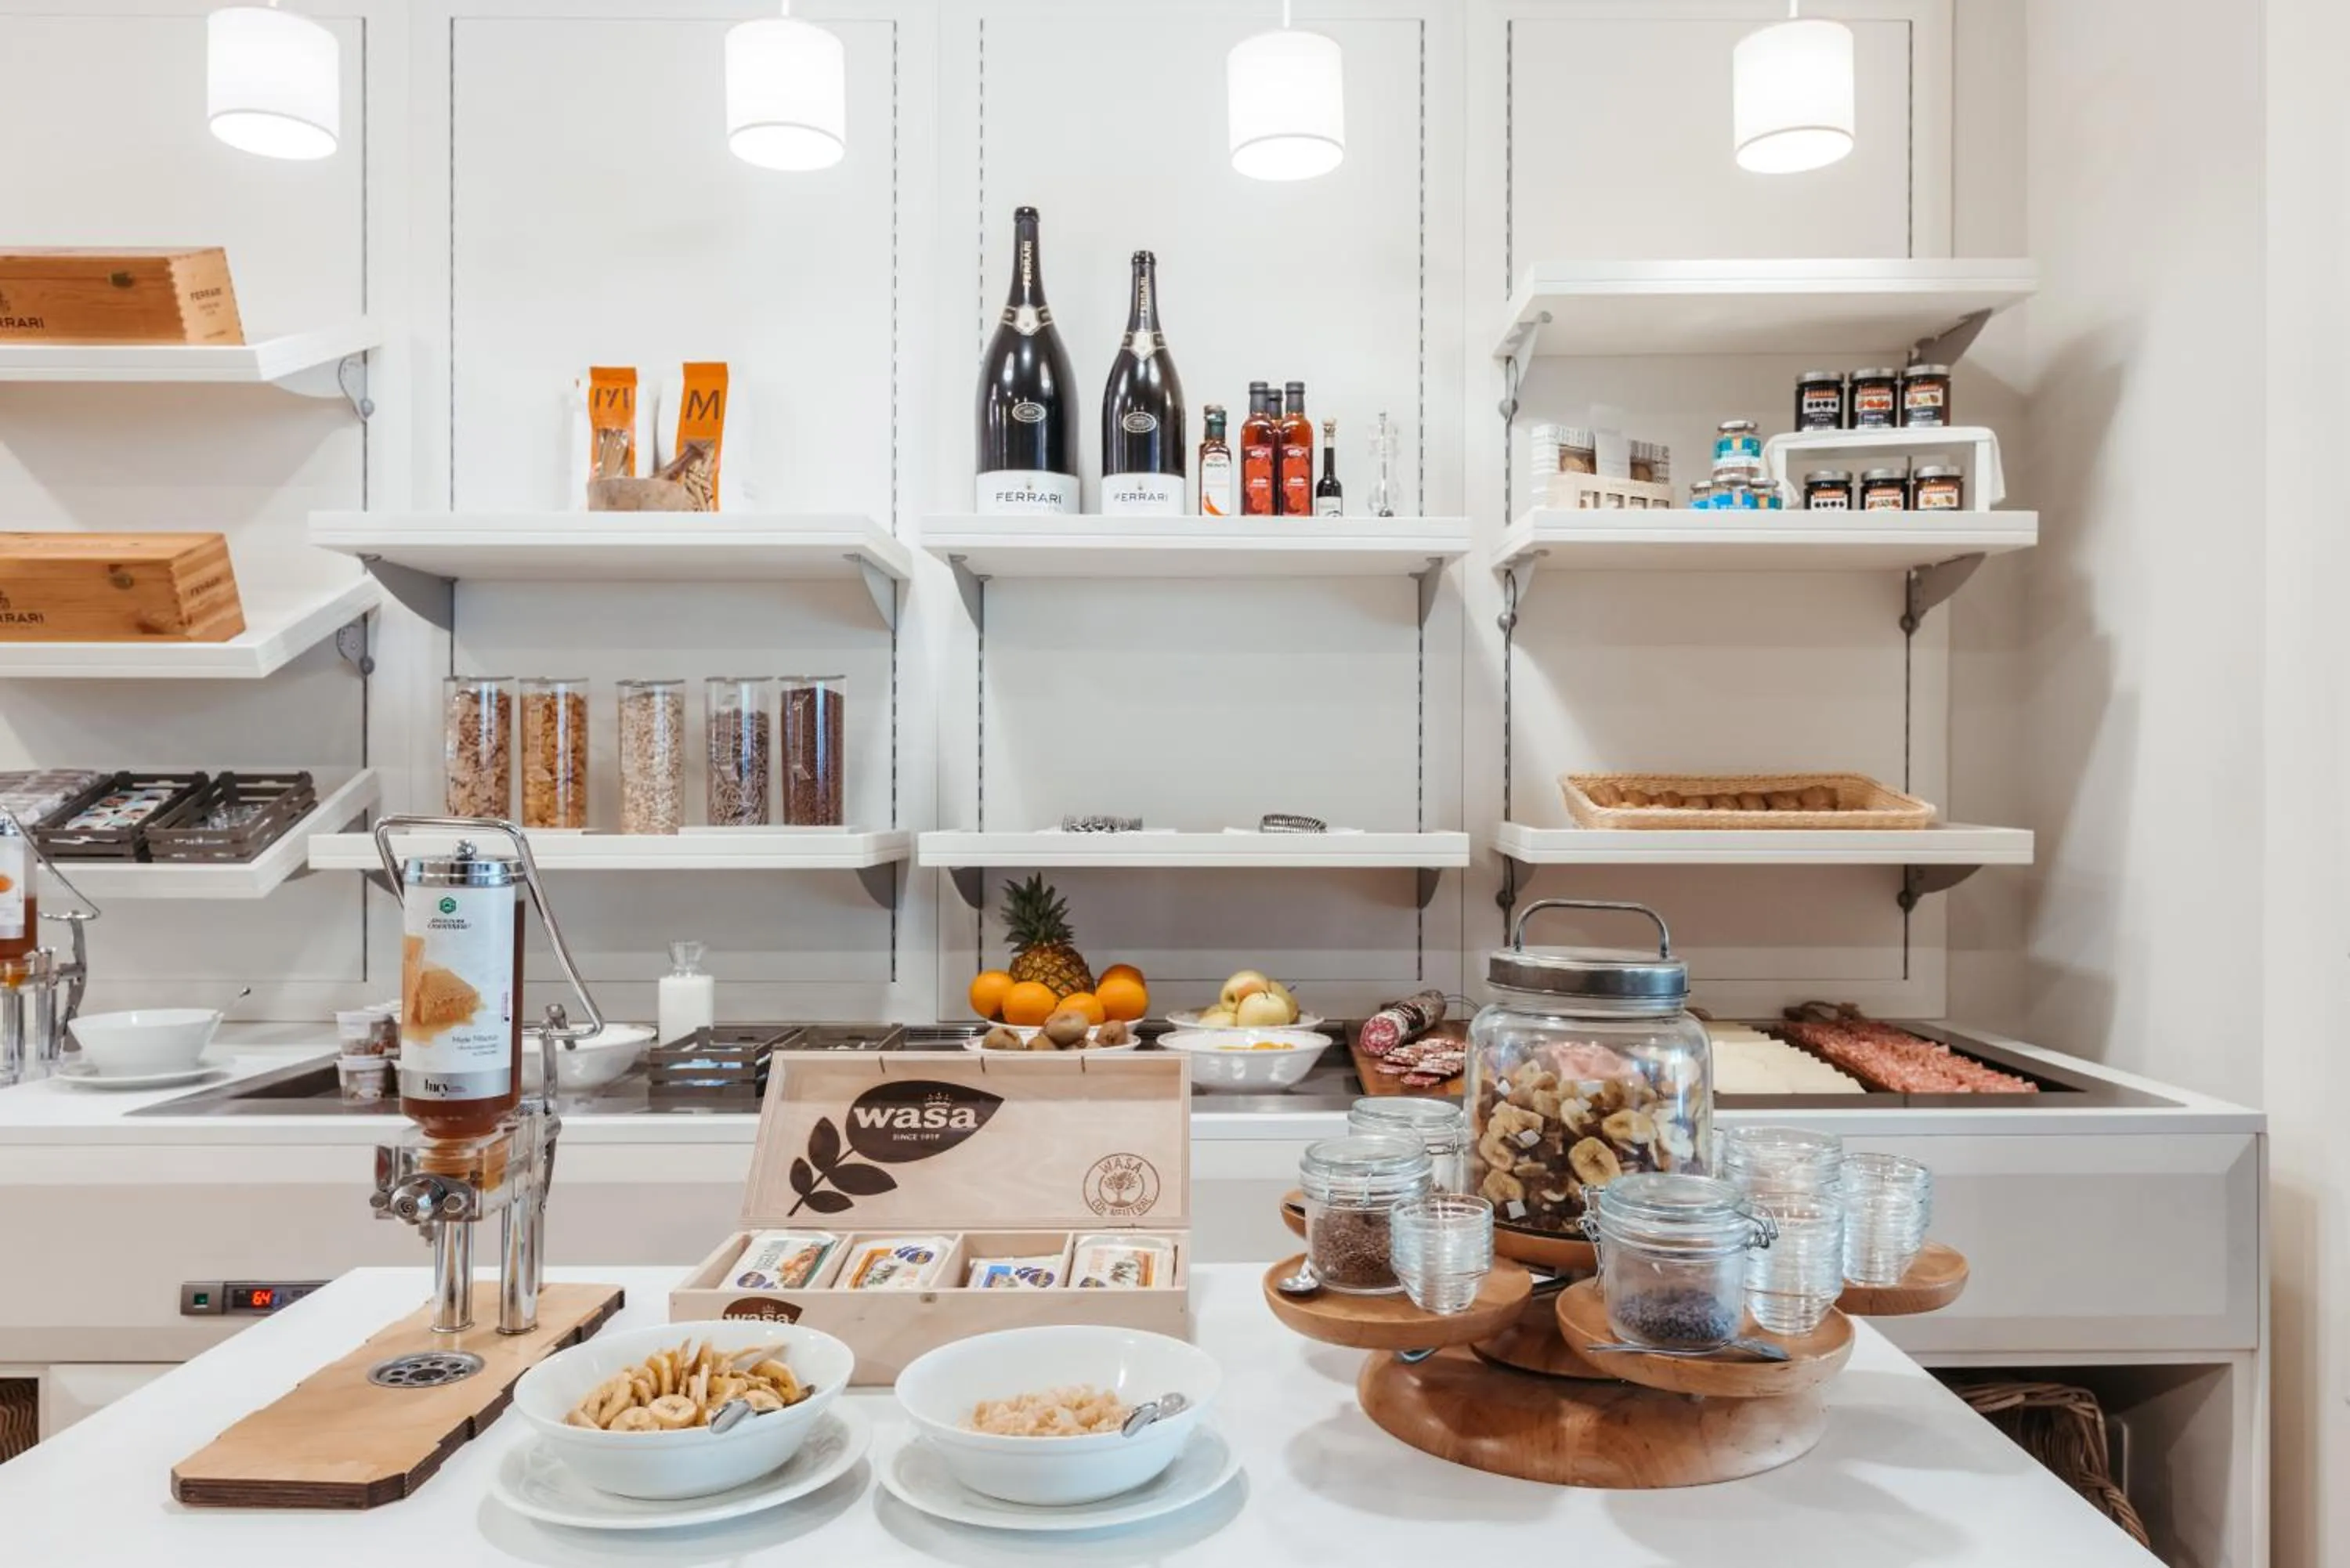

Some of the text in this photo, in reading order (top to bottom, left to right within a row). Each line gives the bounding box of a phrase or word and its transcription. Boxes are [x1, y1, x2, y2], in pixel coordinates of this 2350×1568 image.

[686, 389, 719, 420] M
[996, 492, 1062, 504] FERRARI
[1114, 493, 1169, 502] FERRARI
[0, 613, 45, 624] RARI
[853, 1107, 978, 1129] wasa
[1097, 1157, 1143, 1173] WASA
